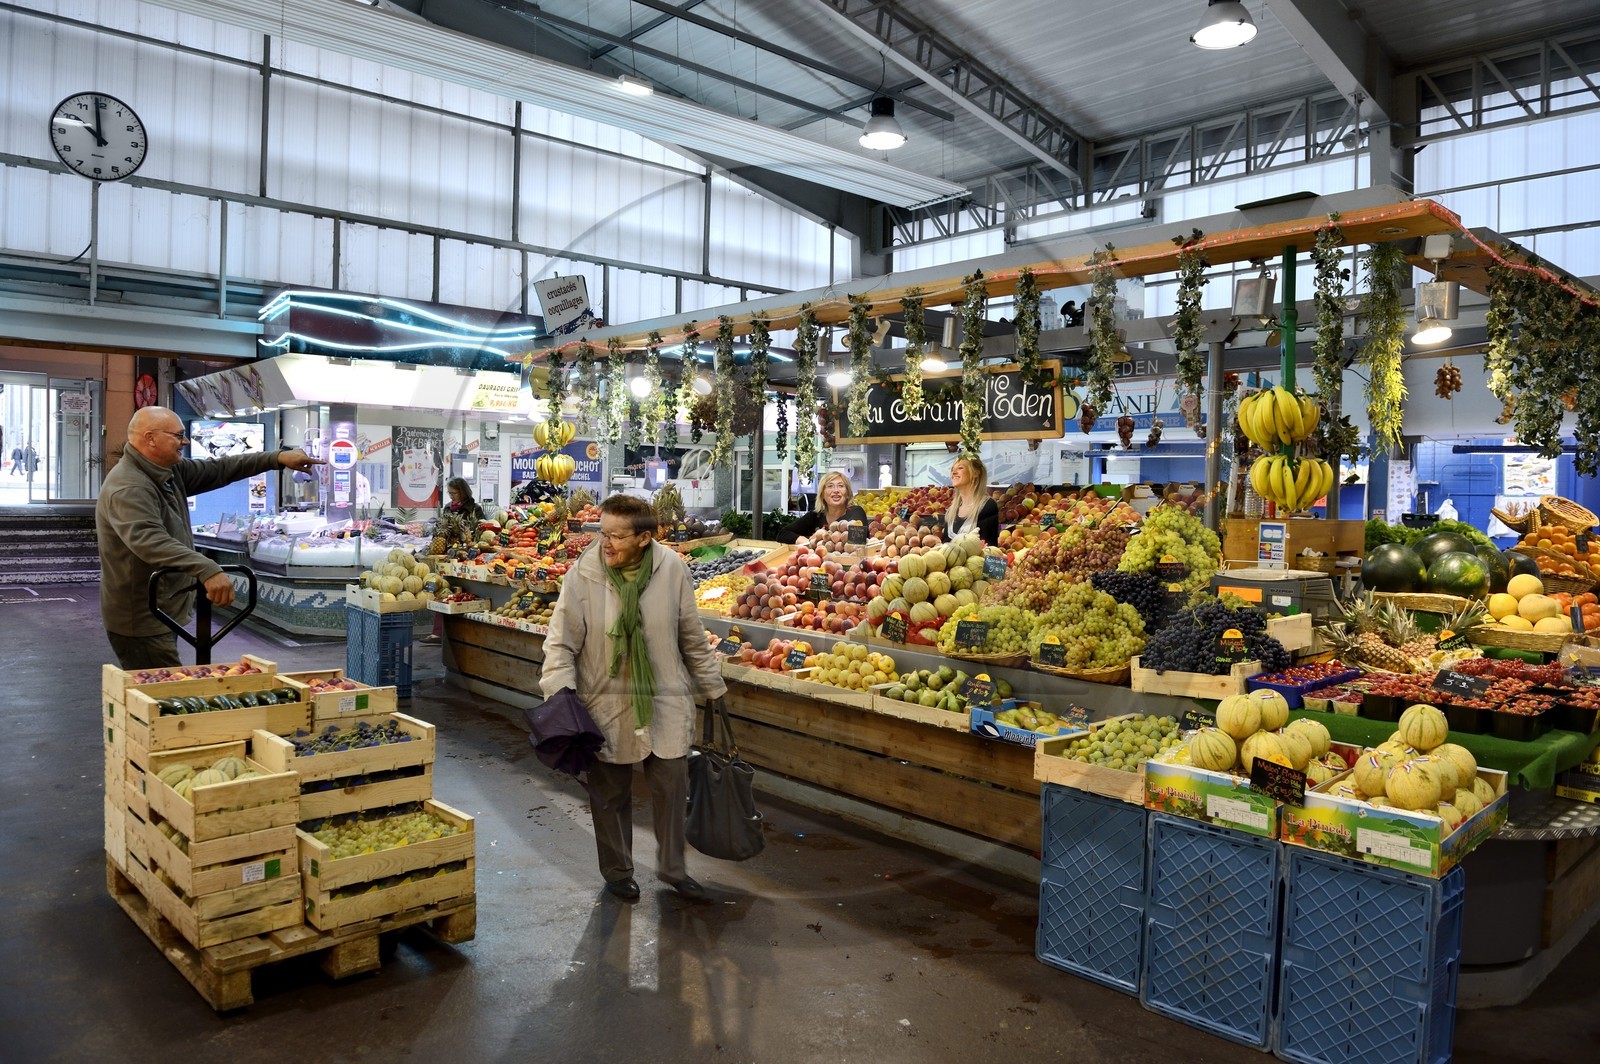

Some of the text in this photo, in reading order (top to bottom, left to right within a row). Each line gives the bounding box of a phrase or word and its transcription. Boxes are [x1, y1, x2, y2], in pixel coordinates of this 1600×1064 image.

[77, 102, 88, 111] 11
[93, 167, 102, 175] 6
[547, 282, 577, 299] crustacés
[548, 296, 584, 315] coquillages
[1149, 781, 1202, 804] La Pinède
[1287, 812, 1306, 827] La
[1308, 817, 1351, 837] Pinède
